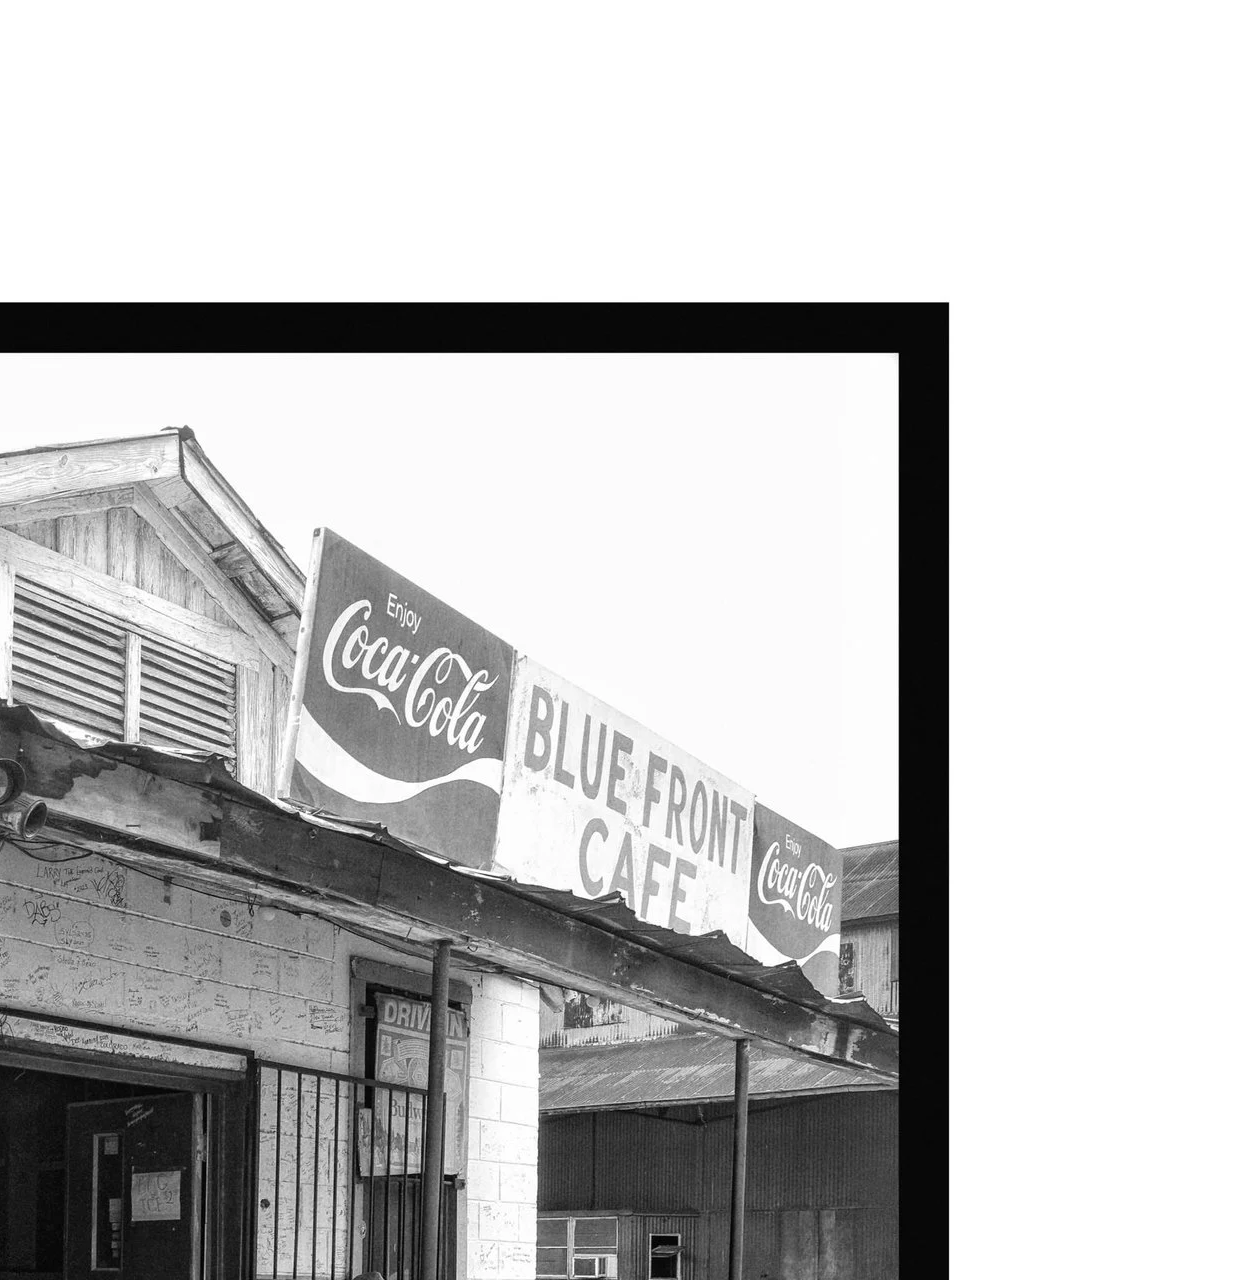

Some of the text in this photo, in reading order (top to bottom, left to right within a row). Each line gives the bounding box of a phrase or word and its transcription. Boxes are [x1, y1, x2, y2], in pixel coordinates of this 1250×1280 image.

[386, 592, 421, 634] Enjoy
[322, 599, 500, 754] Coca-Cola
[523, 684, 748, 875] BLUE FRONT
[579, 817, 697, 934] CAFE
[758, 841, 837, 932] Coca-Cola
[785, 833, 802, 858] Enjoy
[384, 999, 431, 1032] DRIV
